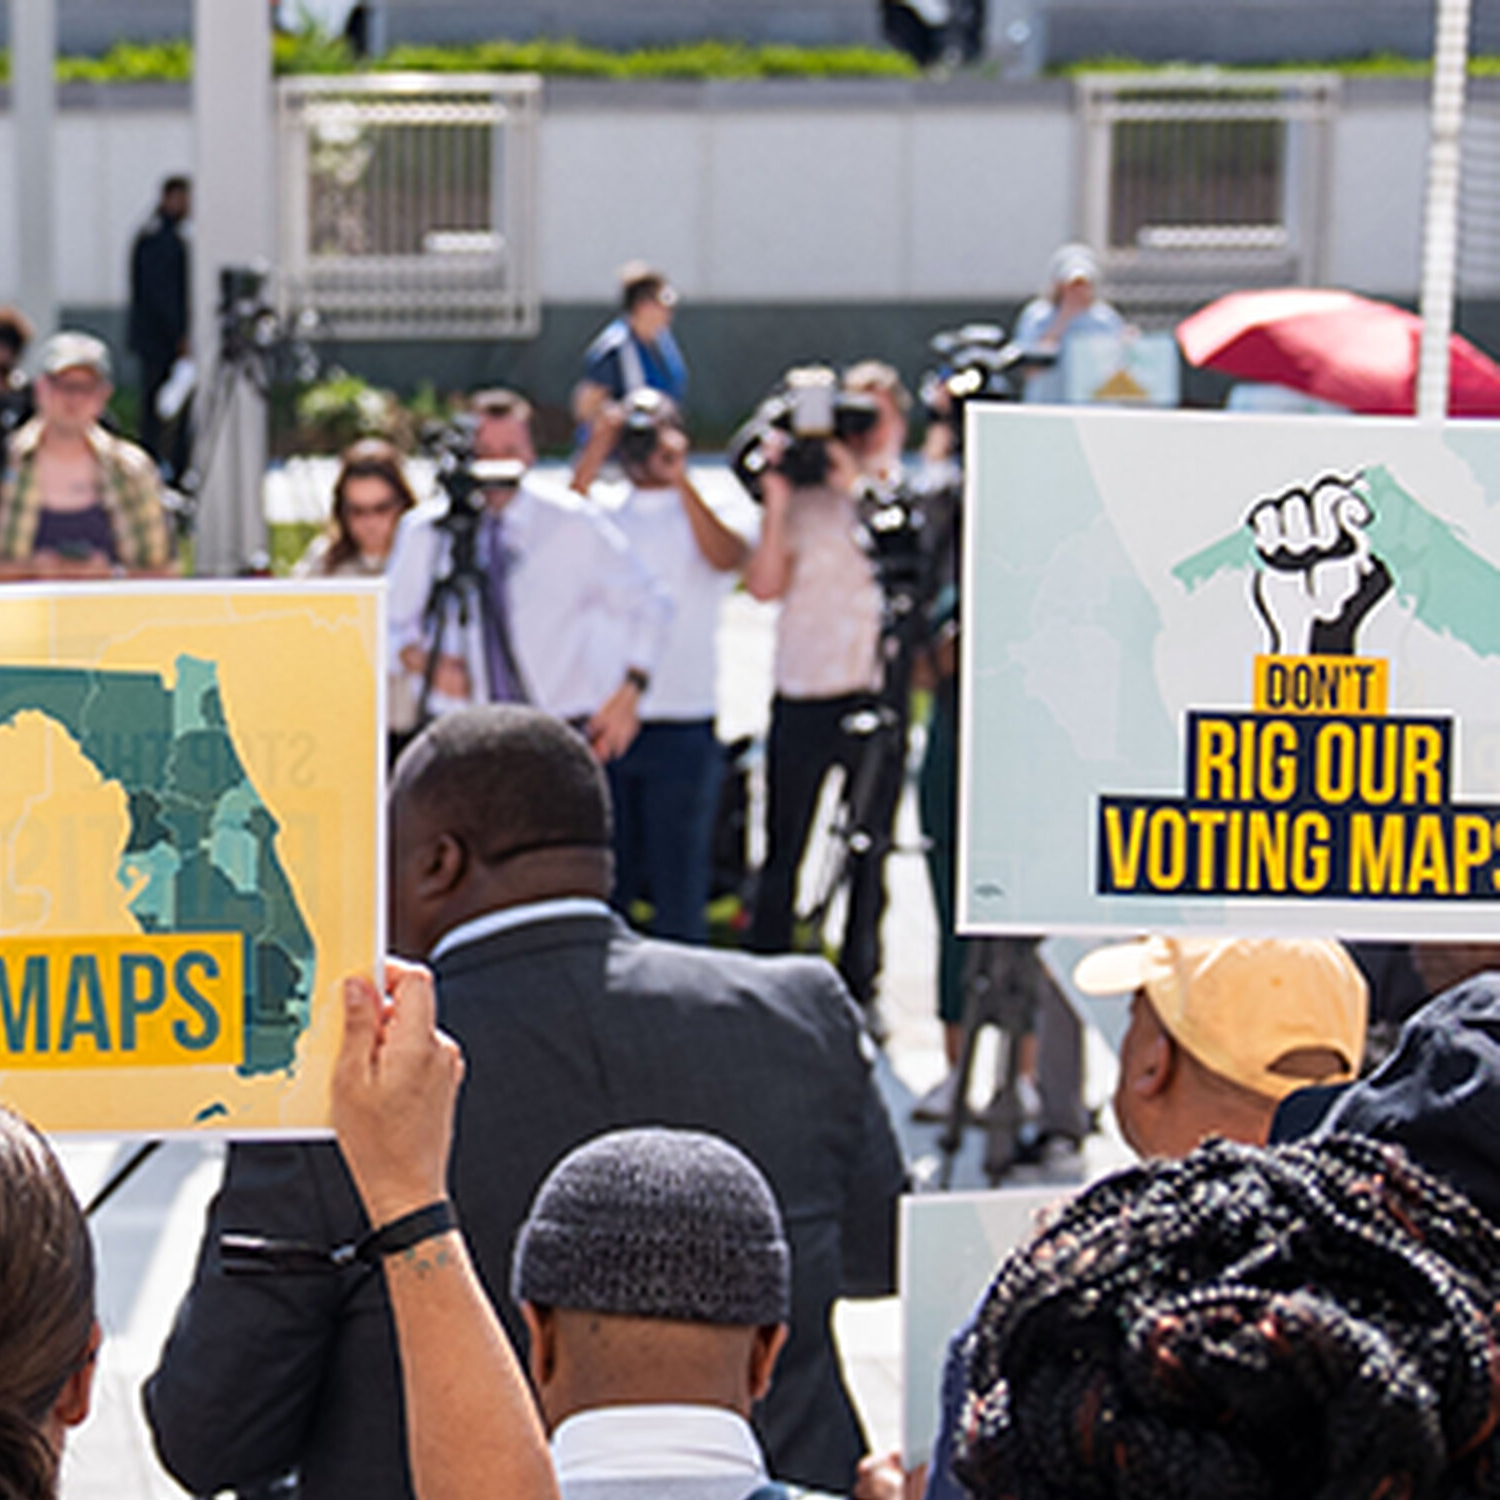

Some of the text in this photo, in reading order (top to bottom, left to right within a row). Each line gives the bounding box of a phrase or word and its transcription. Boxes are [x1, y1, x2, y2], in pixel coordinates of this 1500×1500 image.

[1266, 664, 1375, 709] DON'T
[1196, 720, 1443, 805] RIG OUR
[1104, 806, 1500, 895] VOTING MAP
